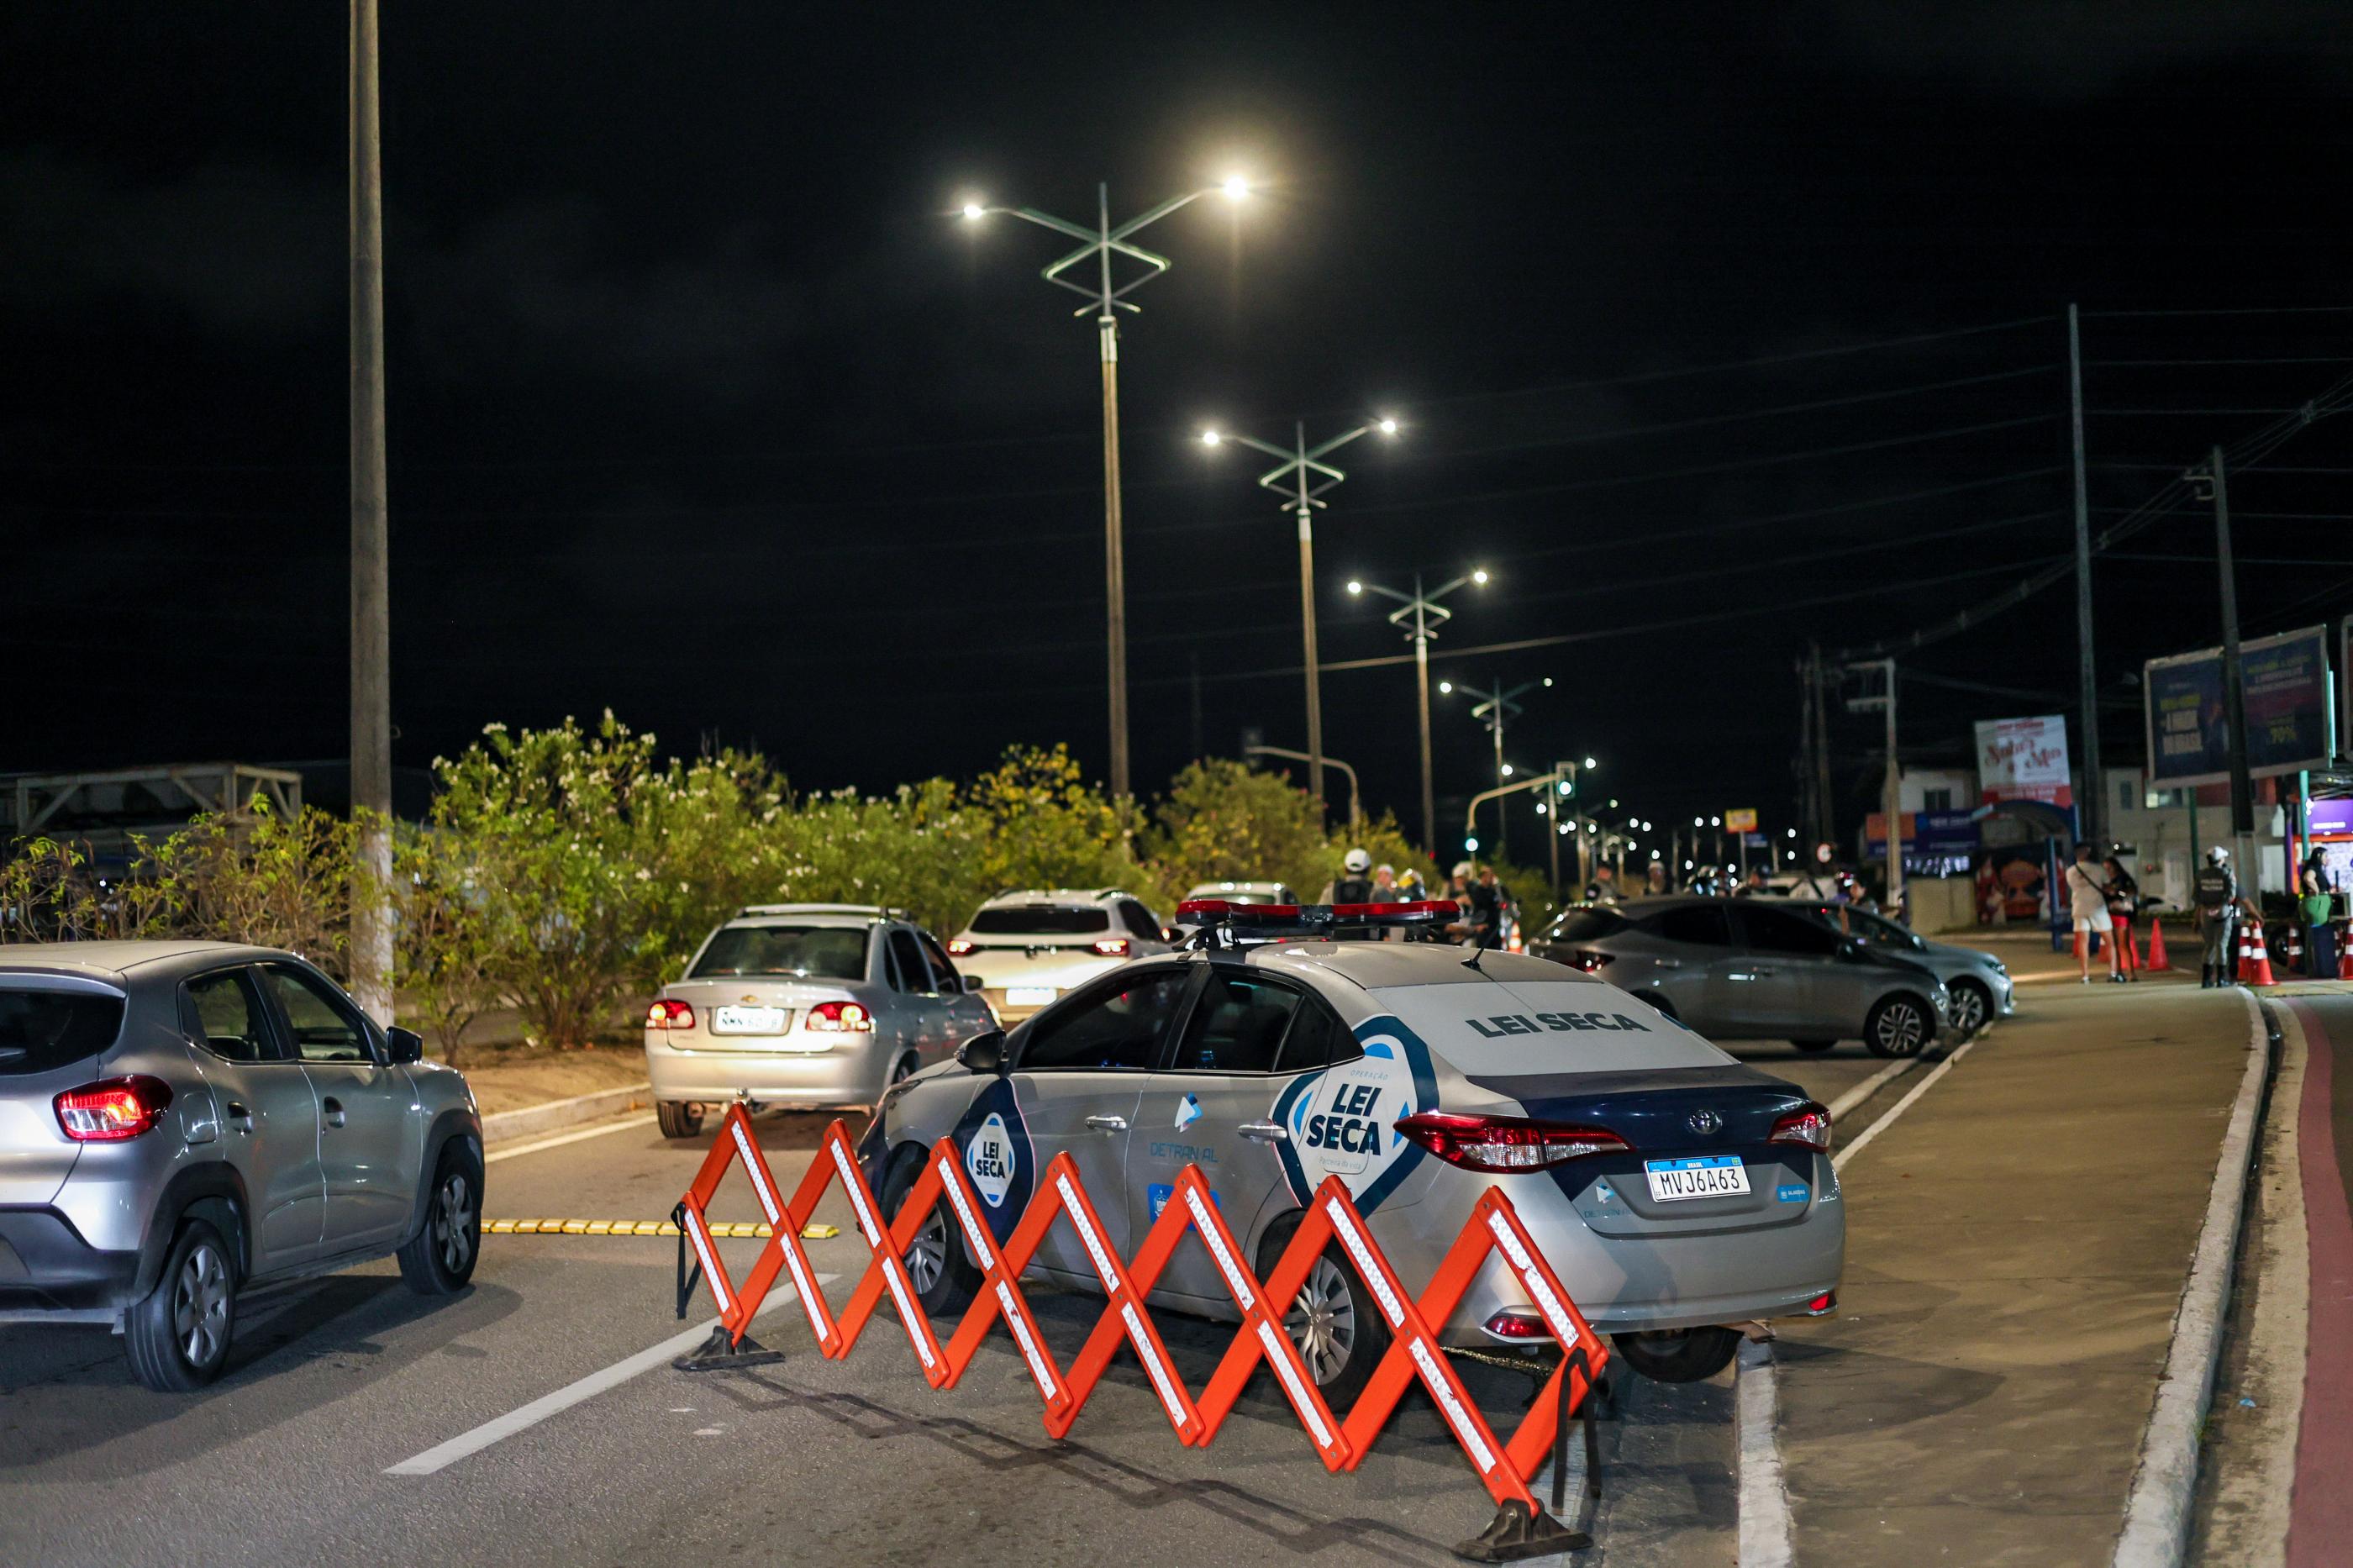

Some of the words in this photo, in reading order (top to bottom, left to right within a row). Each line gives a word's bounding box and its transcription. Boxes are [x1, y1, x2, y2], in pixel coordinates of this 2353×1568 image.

[1465, 1014, 1543, 1038] LEI
[1535, 1013, 1653, 1032] SECA
[1350, 1069, 1388, 1081] OPERAÇÃO
[1331, 1083, 1382, 1118] LEI
[1306, 1114, 1381, 1156] SECA
[982, 1141, 999, 1160] LEI
[1150, 1142, 1199, 1160] DETRAN
[1202, 1147, 1219, 1163] AL
[976, 1159, 1006, 1179] SECA
[1660, 1169, 1740, 1195] MVJ6A63
